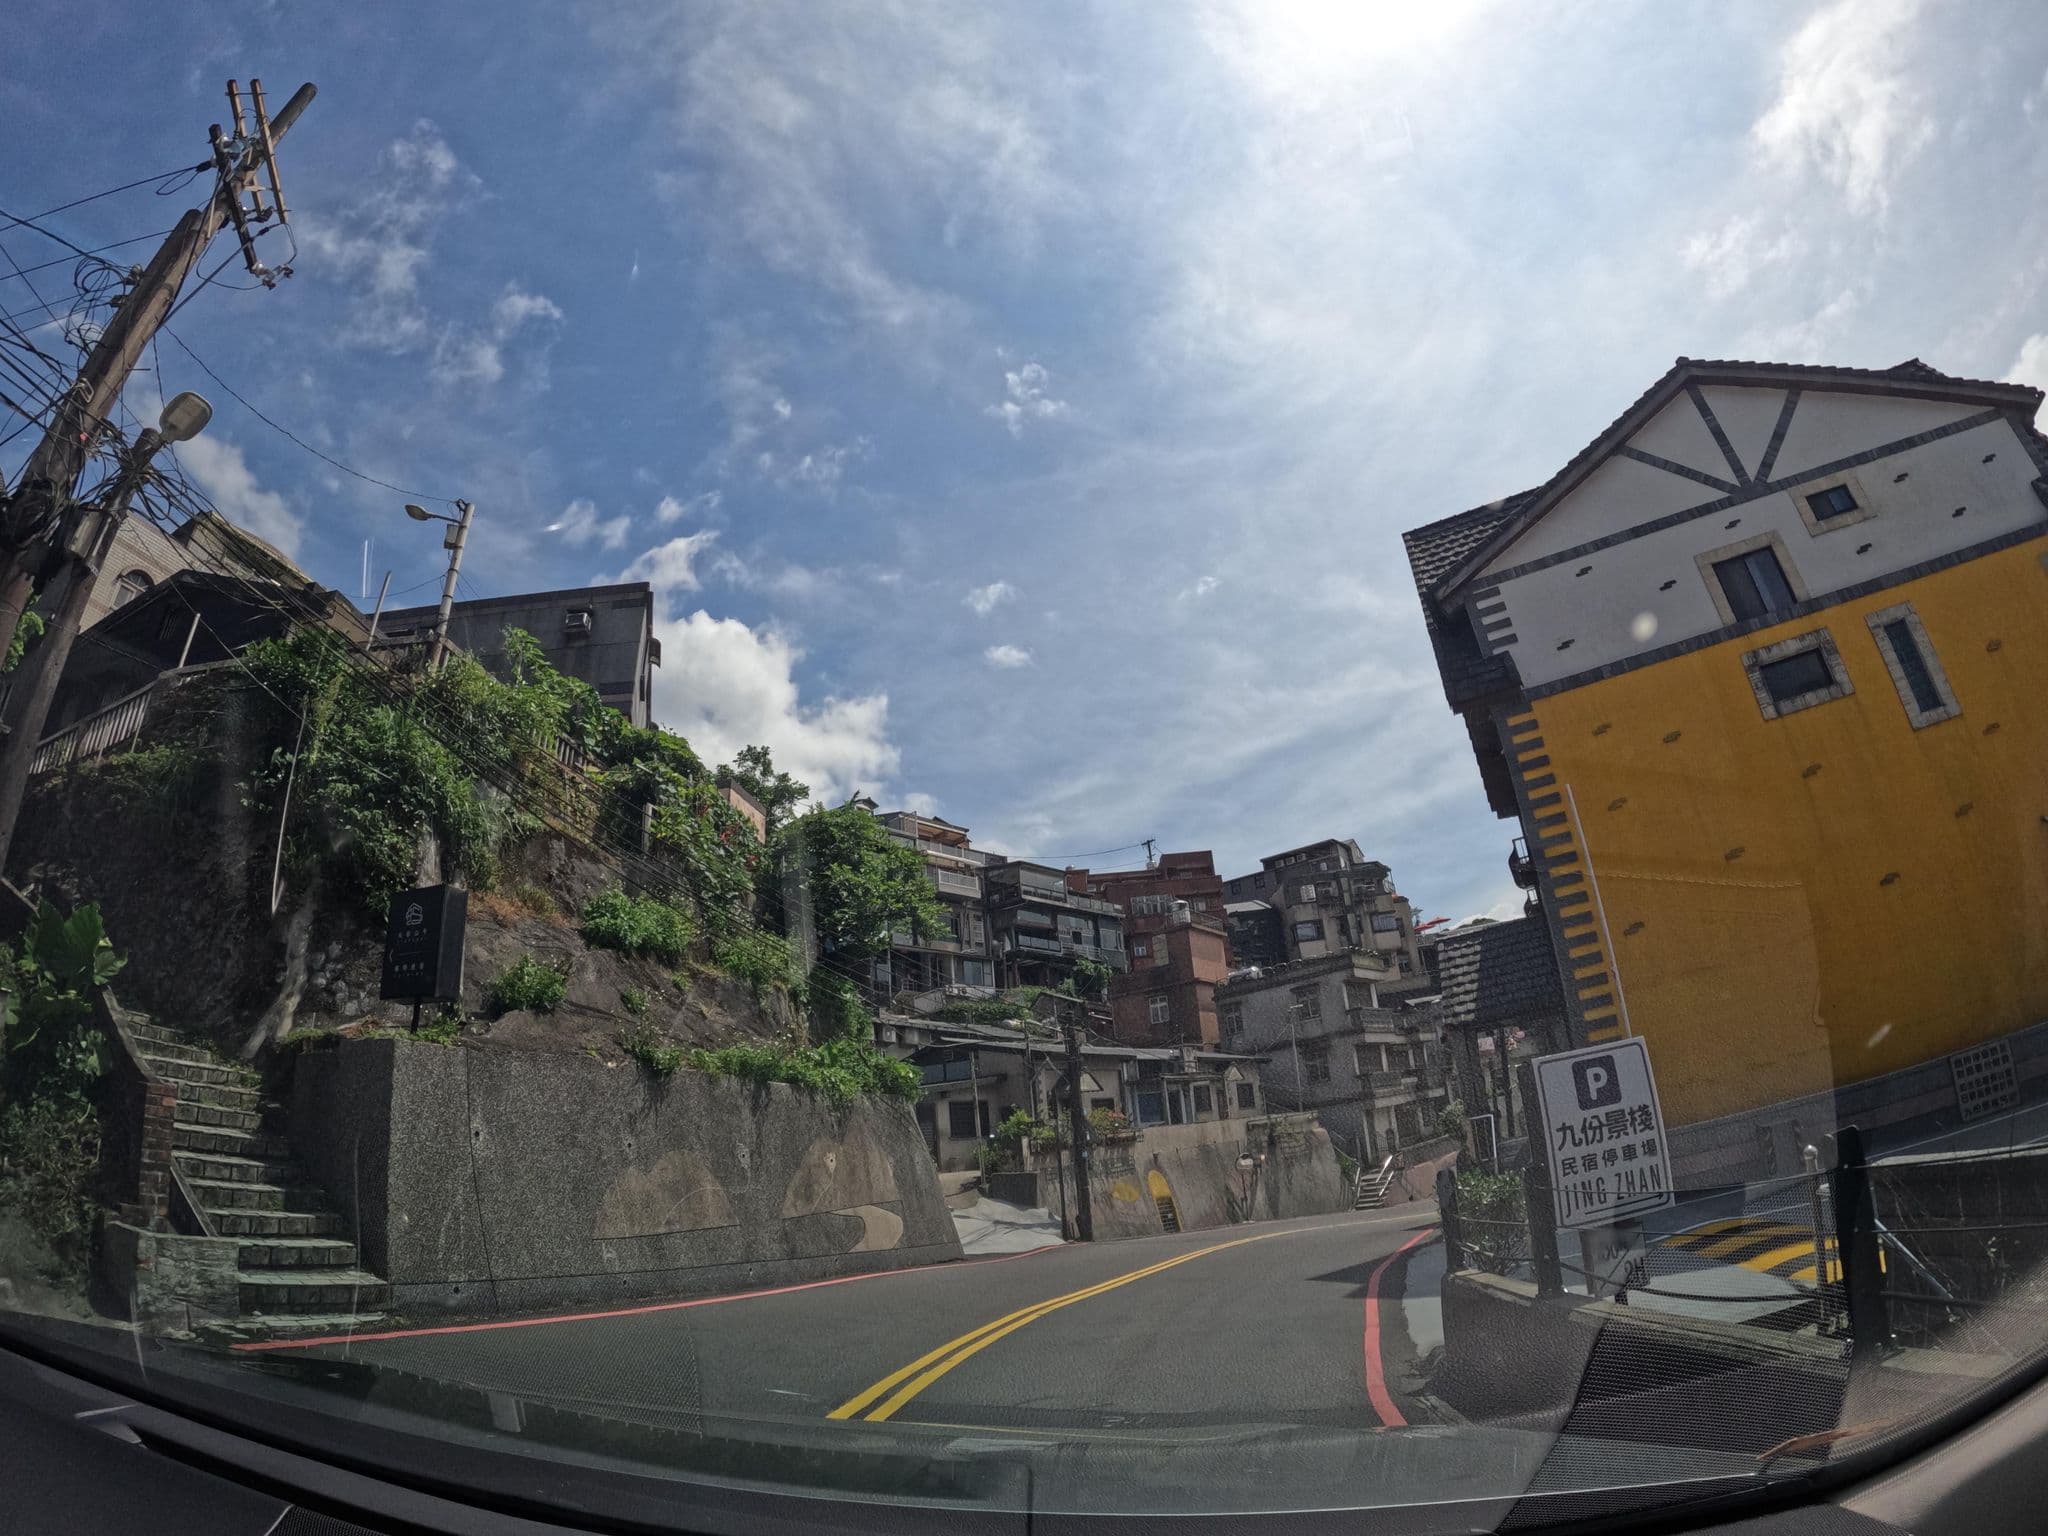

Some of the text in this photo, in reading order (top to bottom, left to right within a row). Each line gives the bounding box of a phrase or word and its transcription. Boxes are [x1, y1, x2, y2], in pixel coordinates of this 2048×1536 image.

[1586, 1067, 1608, 1100] P
[1556, 1104, 1655, 1151] 九份景棧
[1561, 1138, 1658, 1177] 民宿停車場
[1564, 1163, 1662, 1218] JING ZHAN
